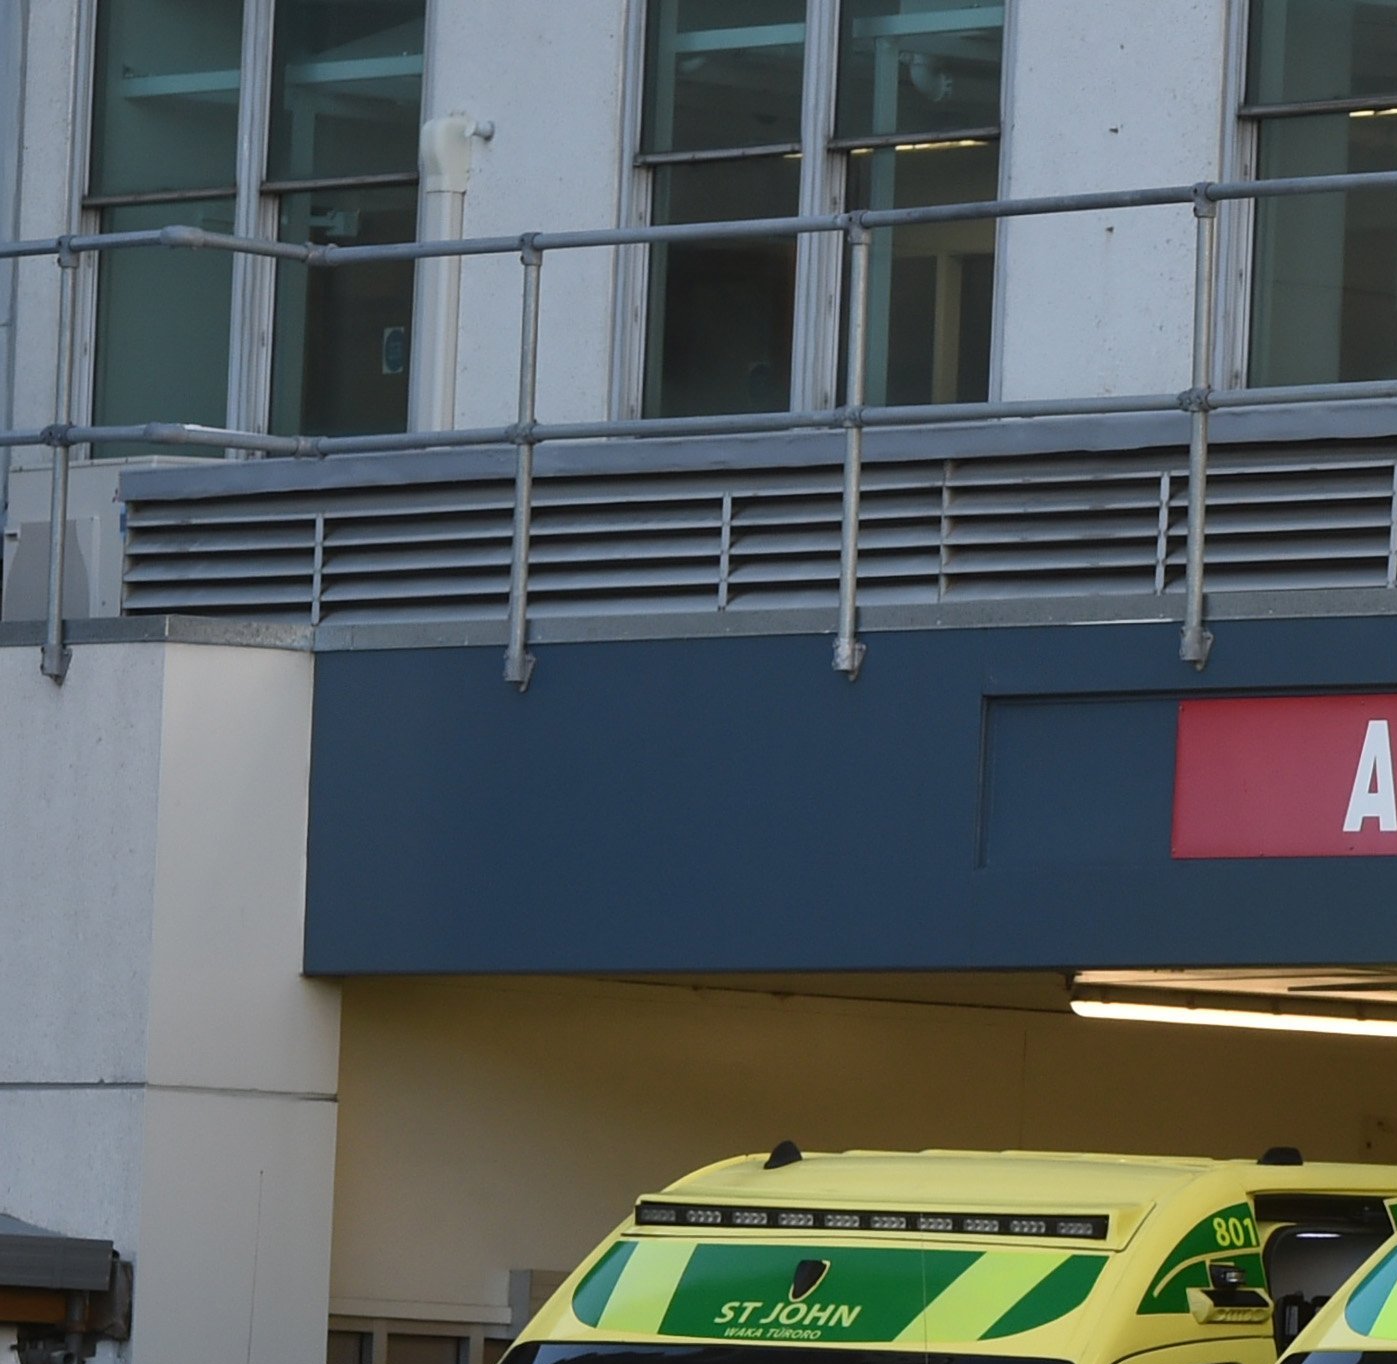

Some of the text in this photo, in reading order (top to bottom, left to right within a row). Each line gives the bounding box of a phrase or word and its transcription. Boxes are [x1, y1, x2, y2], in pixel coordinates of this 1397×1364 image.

[1213, 1217, 1257, 1247] 801
[714, 1301, 861, 1327] ST JOHN
[723, 1326, 763, 1337] WAKA
